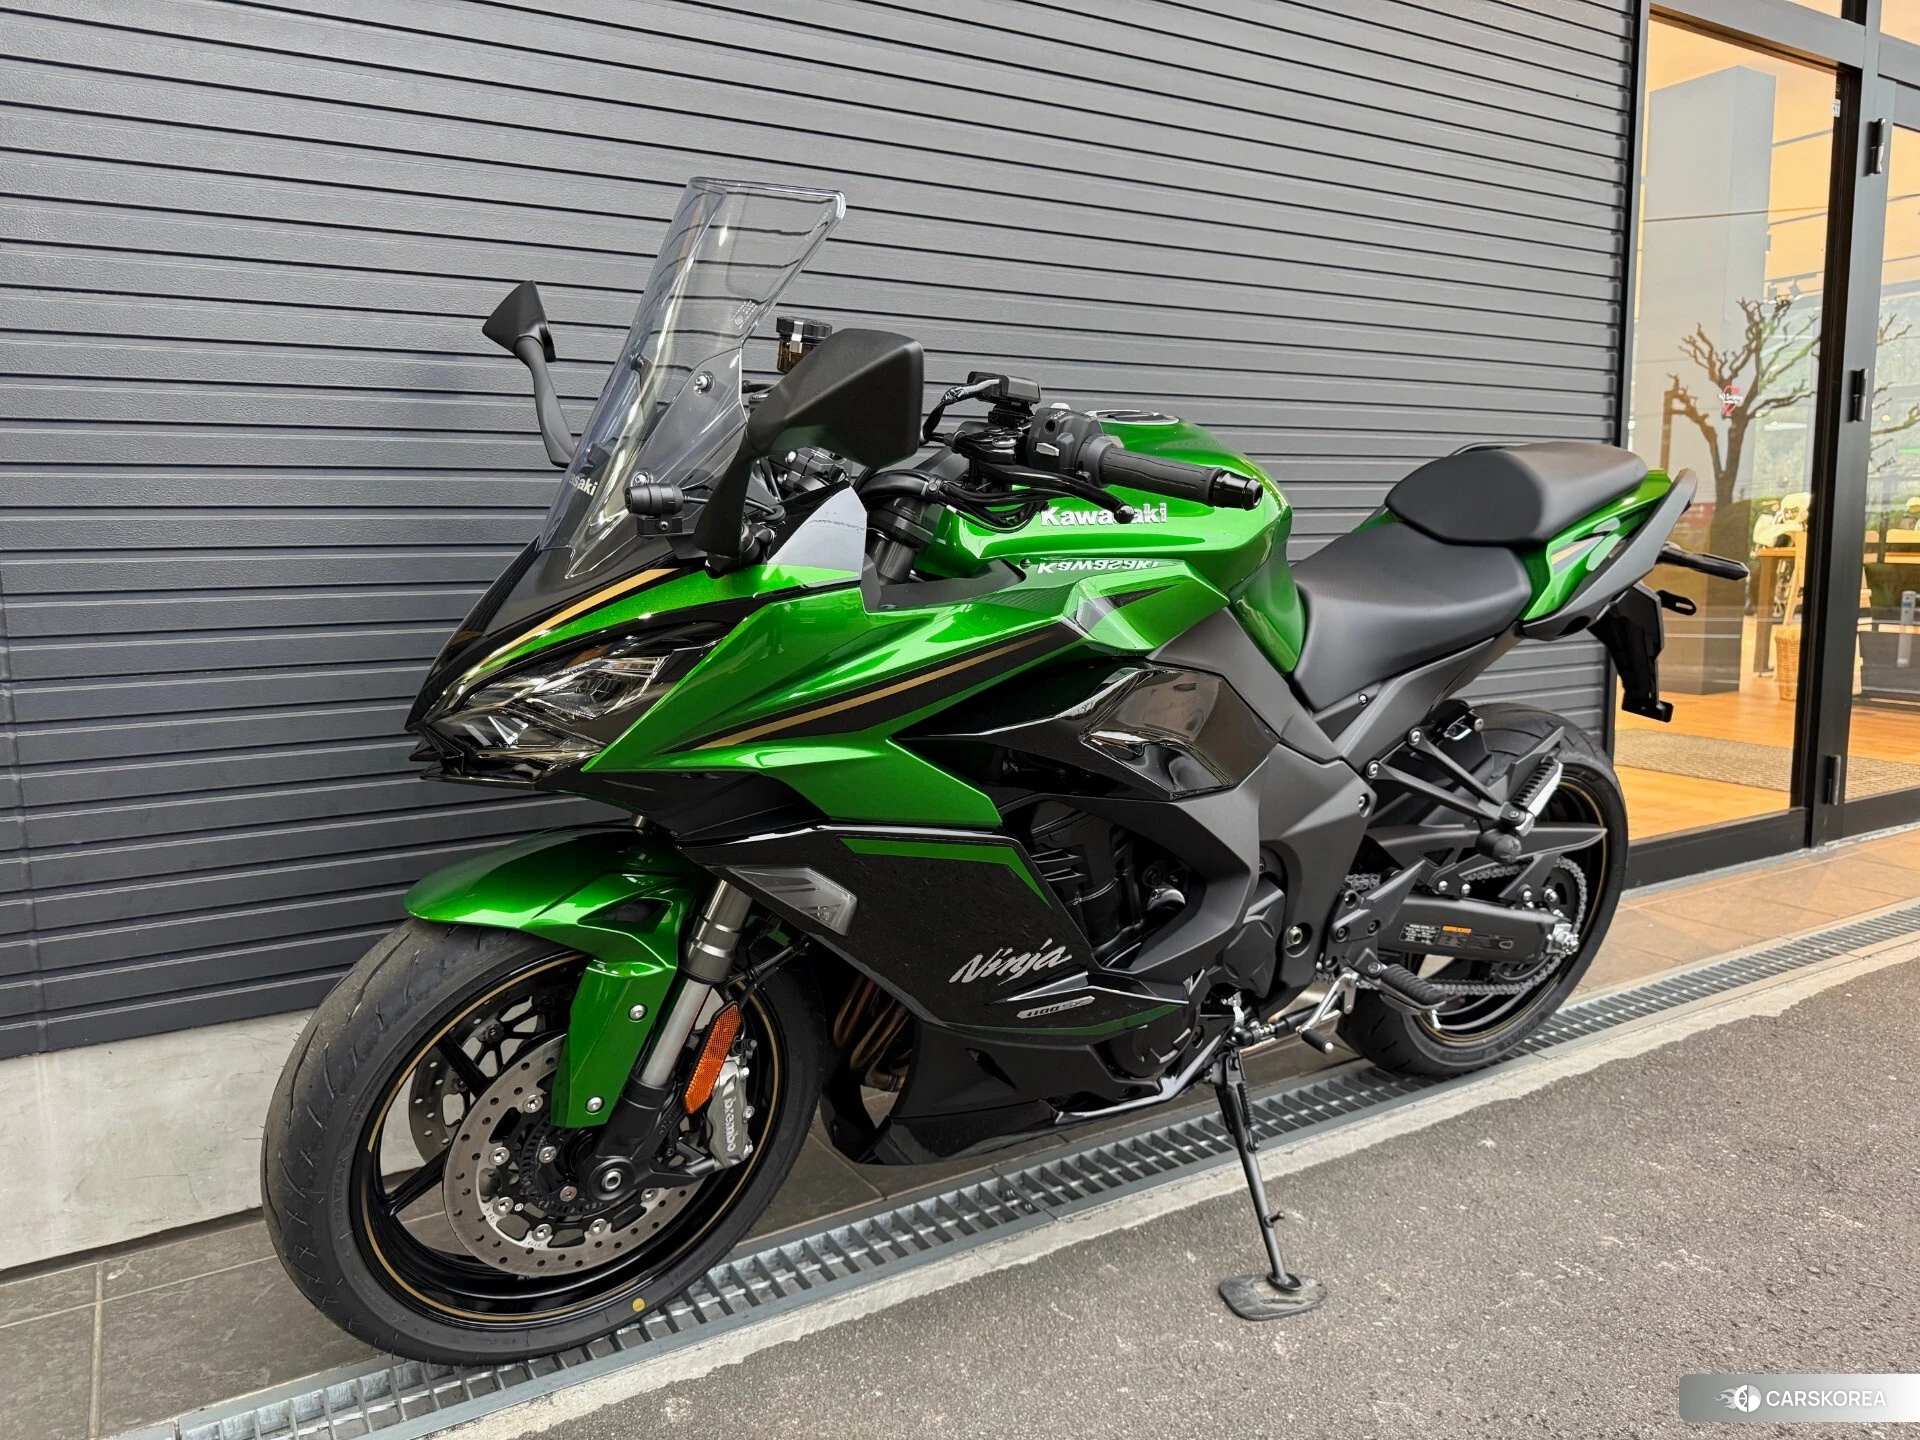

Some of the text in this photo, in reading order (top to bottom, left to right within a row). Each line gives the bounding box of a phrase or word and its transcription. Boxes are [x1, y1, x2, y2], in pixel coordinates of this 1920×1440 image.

[1041, 502, 1168, 526] Kawaaki
[949, 938, 1073, 986] Ninja
[724, 1097, 738, 1152] brembo
